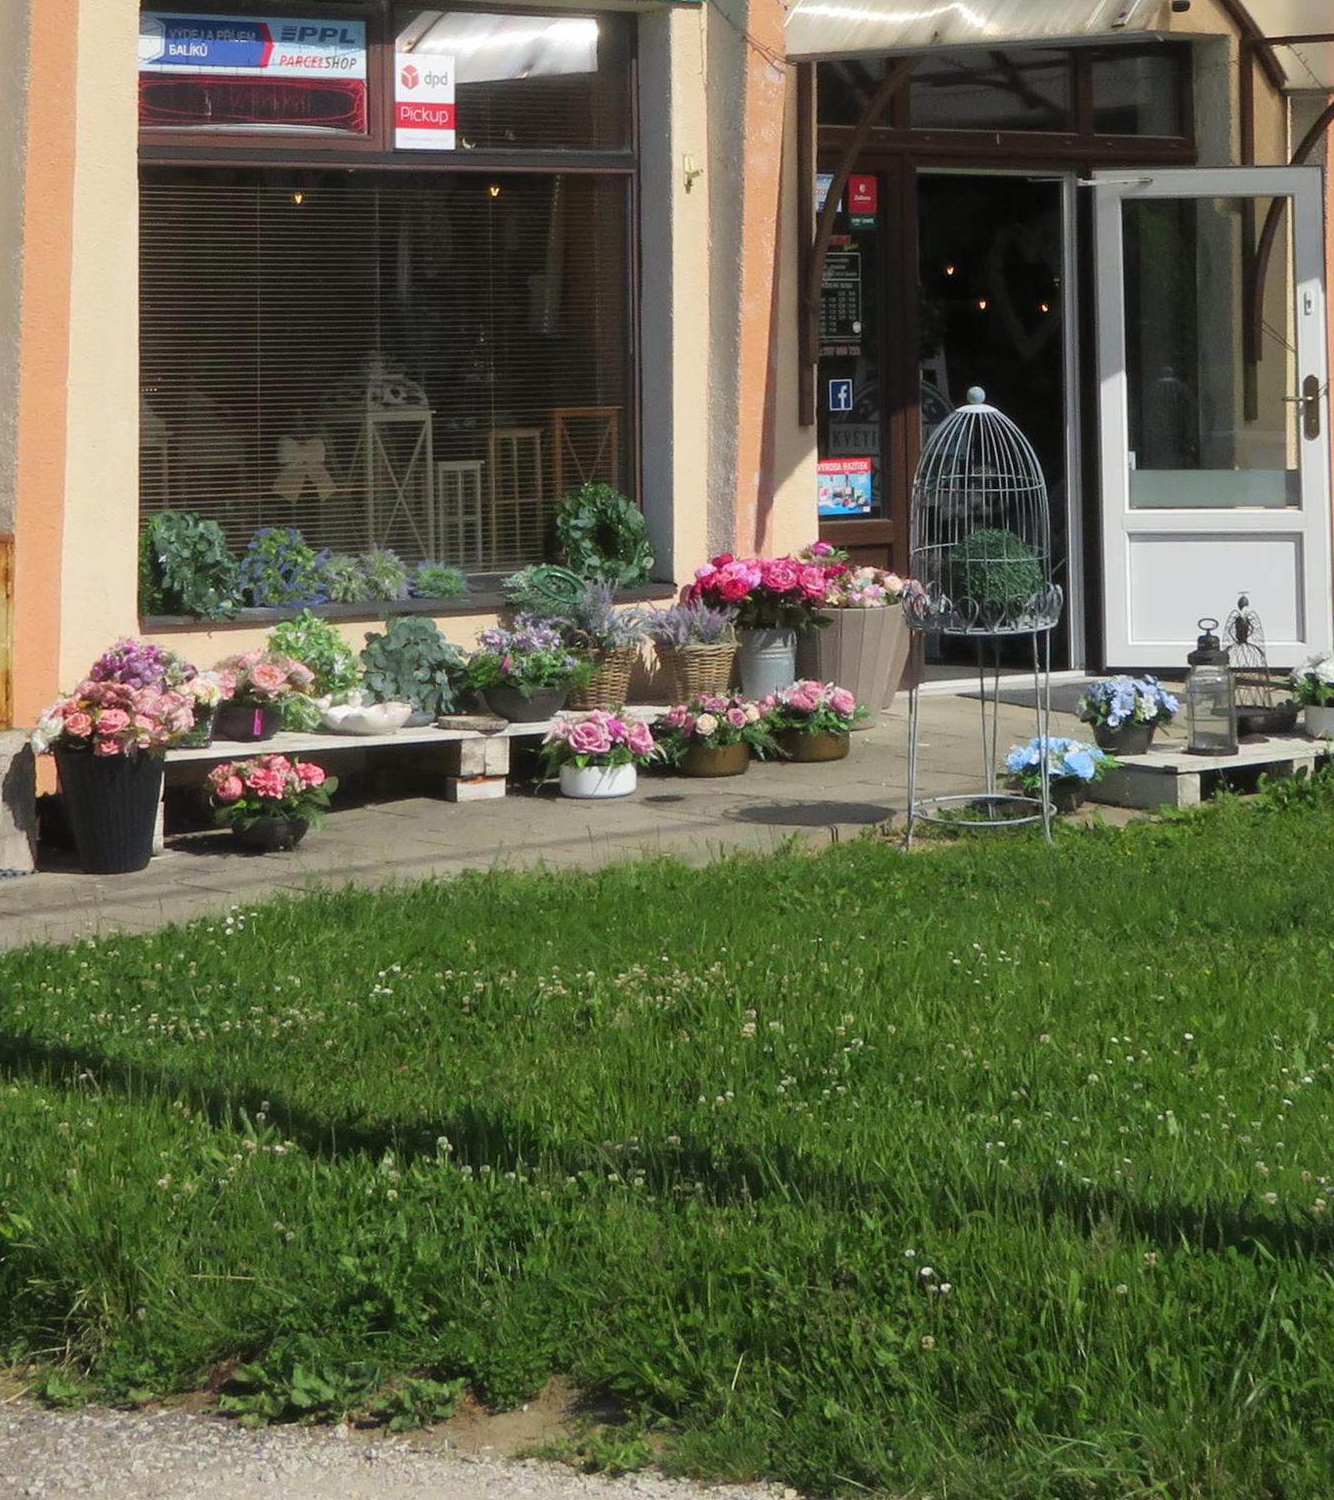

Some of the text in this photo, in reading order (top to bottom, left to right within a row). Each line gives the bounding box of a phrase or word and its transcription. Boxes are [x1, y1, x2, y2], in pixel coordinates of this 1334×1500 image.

[207, 30, 215, 41] A
[423, 70, 449, 88] dpd
[400, 106, 449, 126] Pickup
